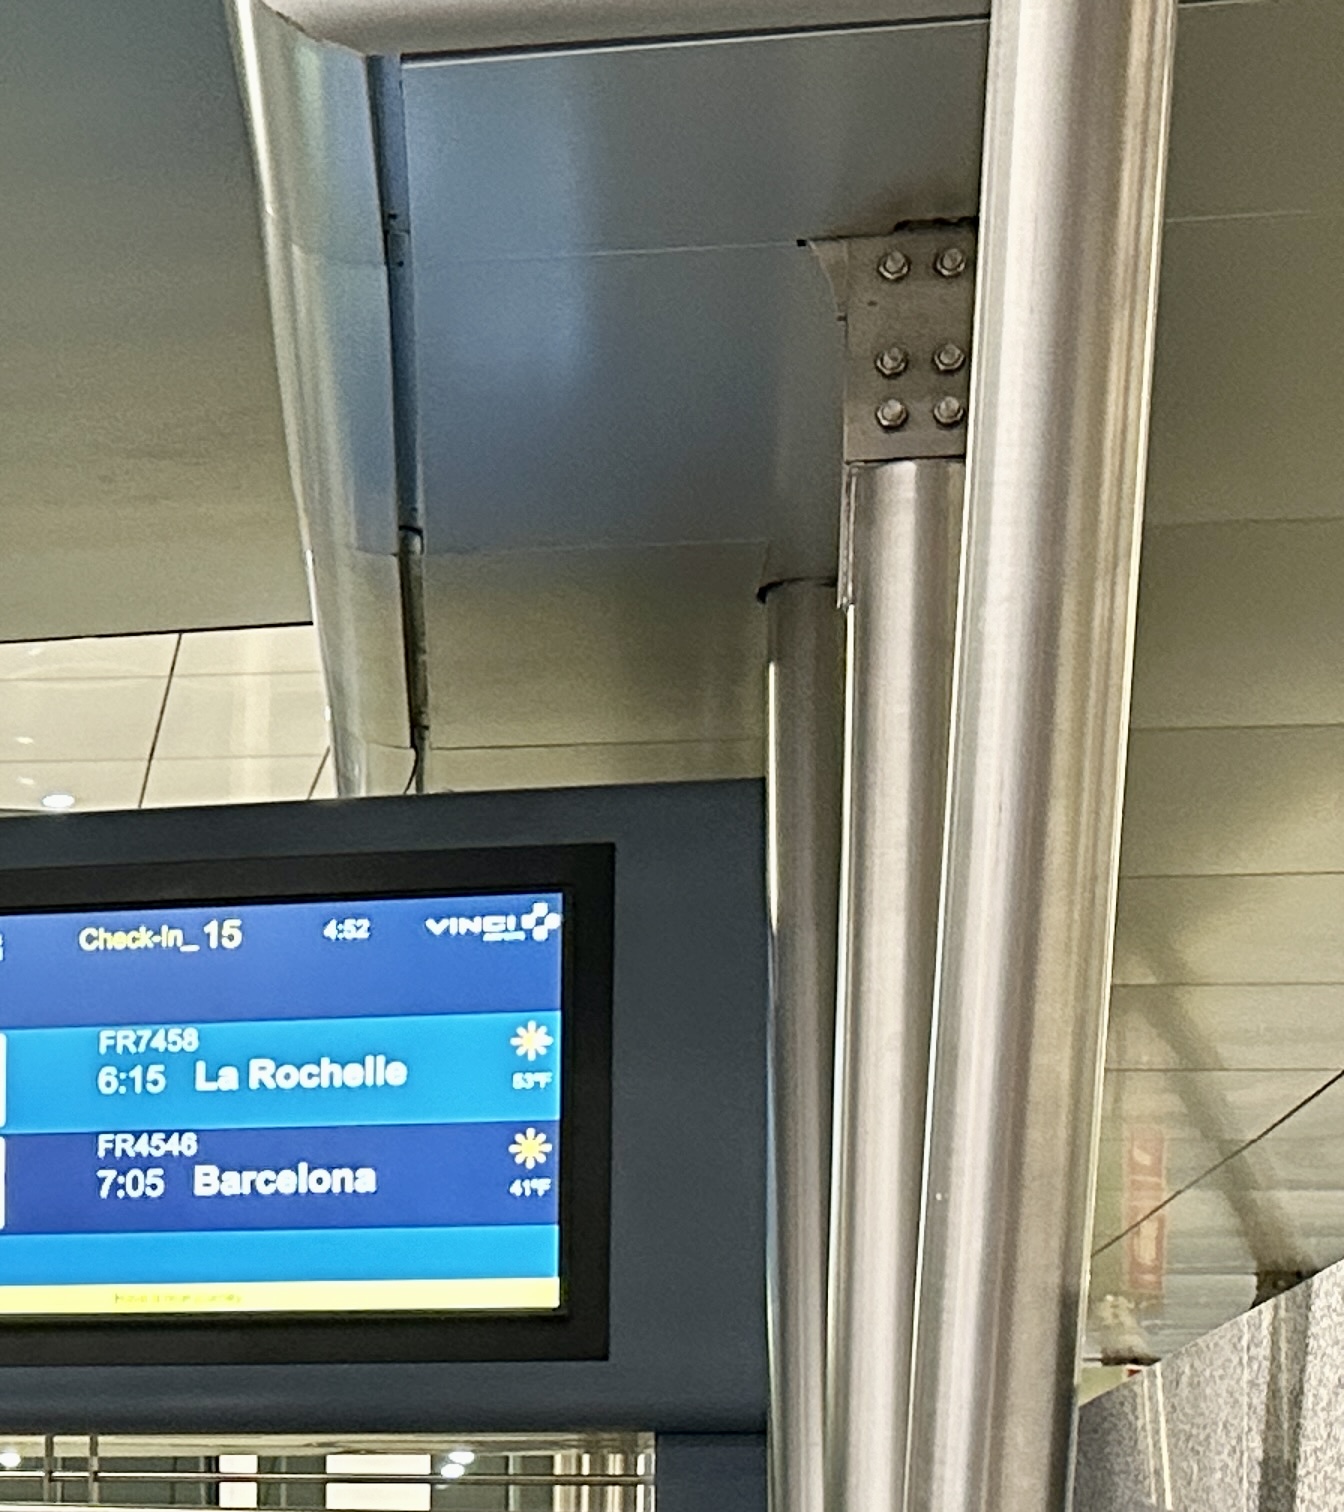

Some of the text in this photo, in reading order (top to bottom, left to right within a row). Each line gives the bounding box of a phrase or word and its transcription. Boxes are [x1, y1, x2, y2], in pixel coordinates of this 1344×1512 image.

[203, 920, 242, 949] 15
[323, 918, 370, 940] 4:52
[425, 915, 516, 936] VINCI
[99, 1027, 199, 1054] FR7458
[98, 1054, 408, 1094] 6:15 La Rochelle
[97, 1131, 198, 1158] FR4546
[97, 1162, 377, 1199] 7:05 Barcelona
